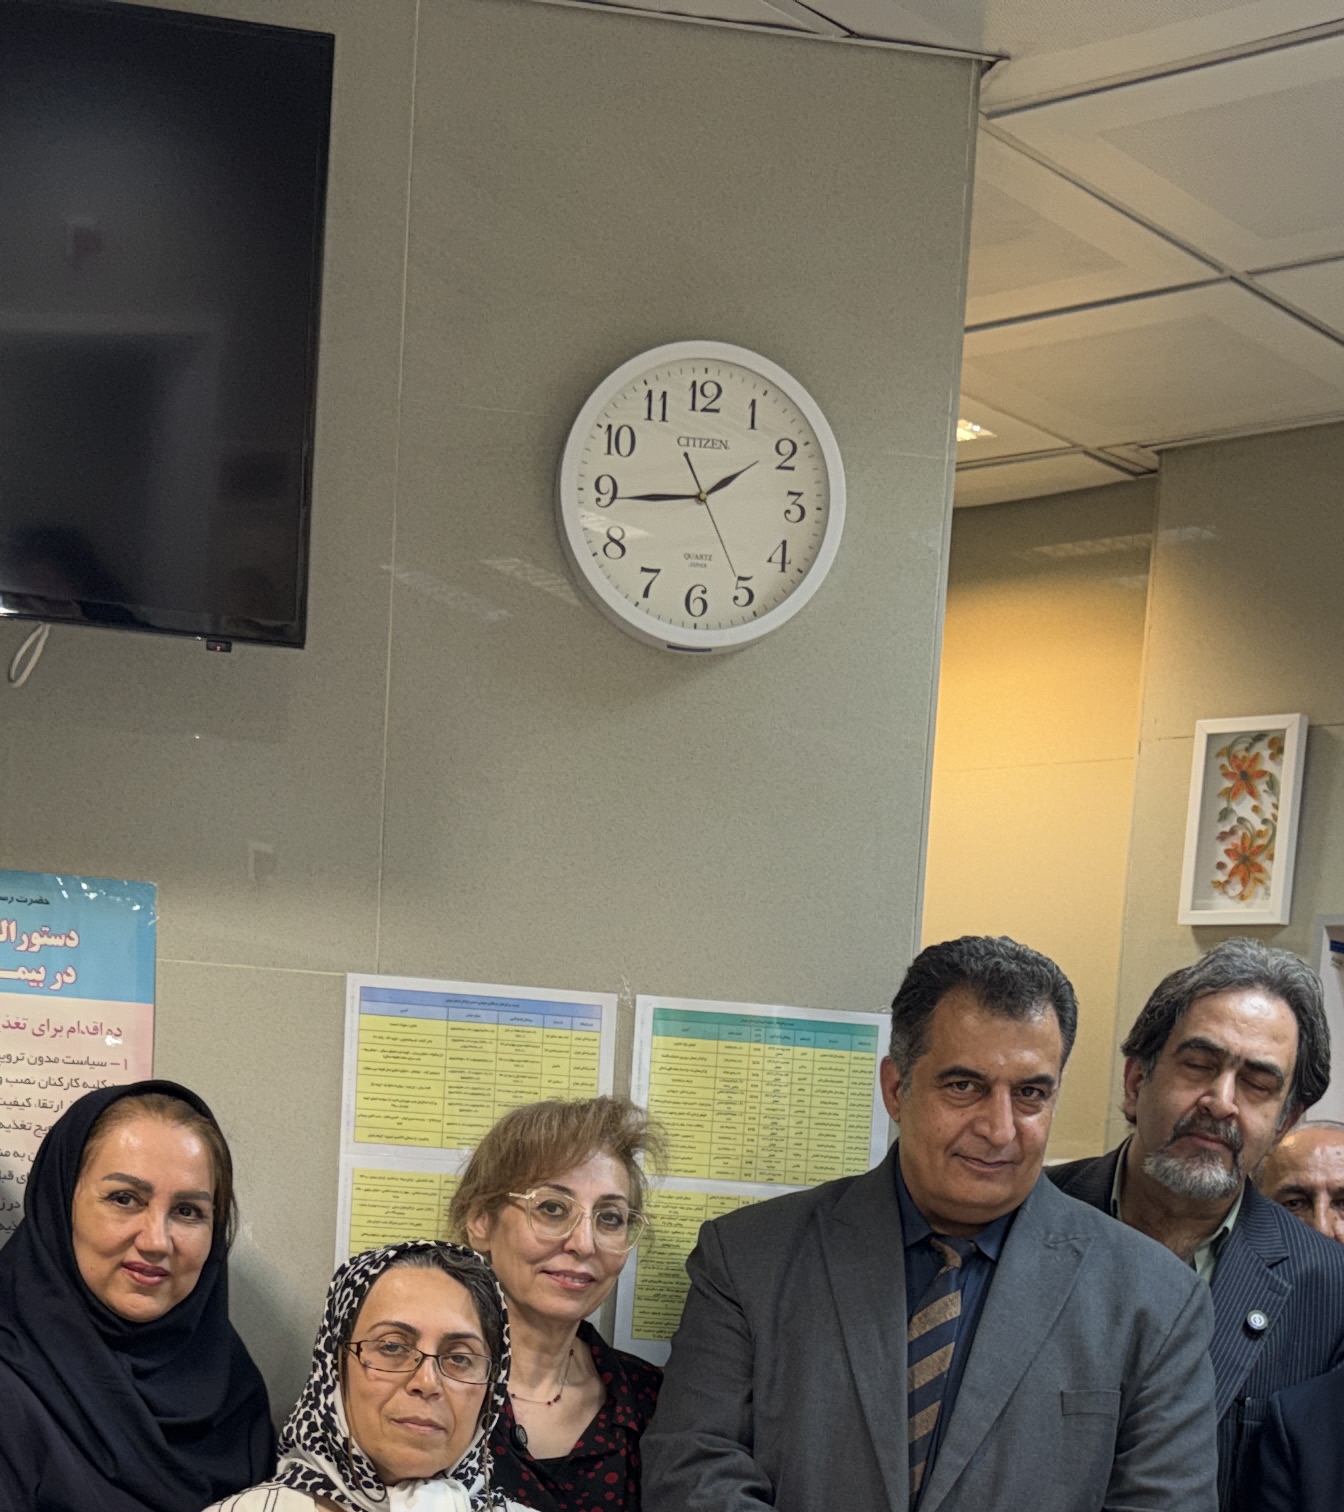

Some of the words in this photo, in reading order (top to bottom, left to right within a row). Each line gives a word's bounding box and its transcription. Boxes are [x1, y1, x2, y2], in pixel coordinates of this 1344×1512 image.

[644, 389, 669, 422] 11
[689, 380, 722, 413] 12
[747, 399, 757, 430] 1
[603, 424, 636, 458] 10
[677, 436, 728, 450] CITIZEN
[774, 438, 798, 471] 2
[594, 474, 618, 508] 9
[783, 490, 806, 523] 3
[602, 526, 627, 559] 8
[683, 553, 712, 562] QUARTZ
[766, 539, 792, 573] 4
[639, 566, 661, 599] 7
[732, 575, 755, 607] 5
[684, 584, 708, 617] 6
[48, 965, 78, 991] در
[31, 1018, 63, 1038] برای
[66, 1021, 104, 1039] اقدام
[27, 1053, 60, 1066] مدون
[61, 1055, 107, 1070] سیاست
[38, 1077, 80, 1091] کارکنان
[13, 1151, 26, 1162] به
